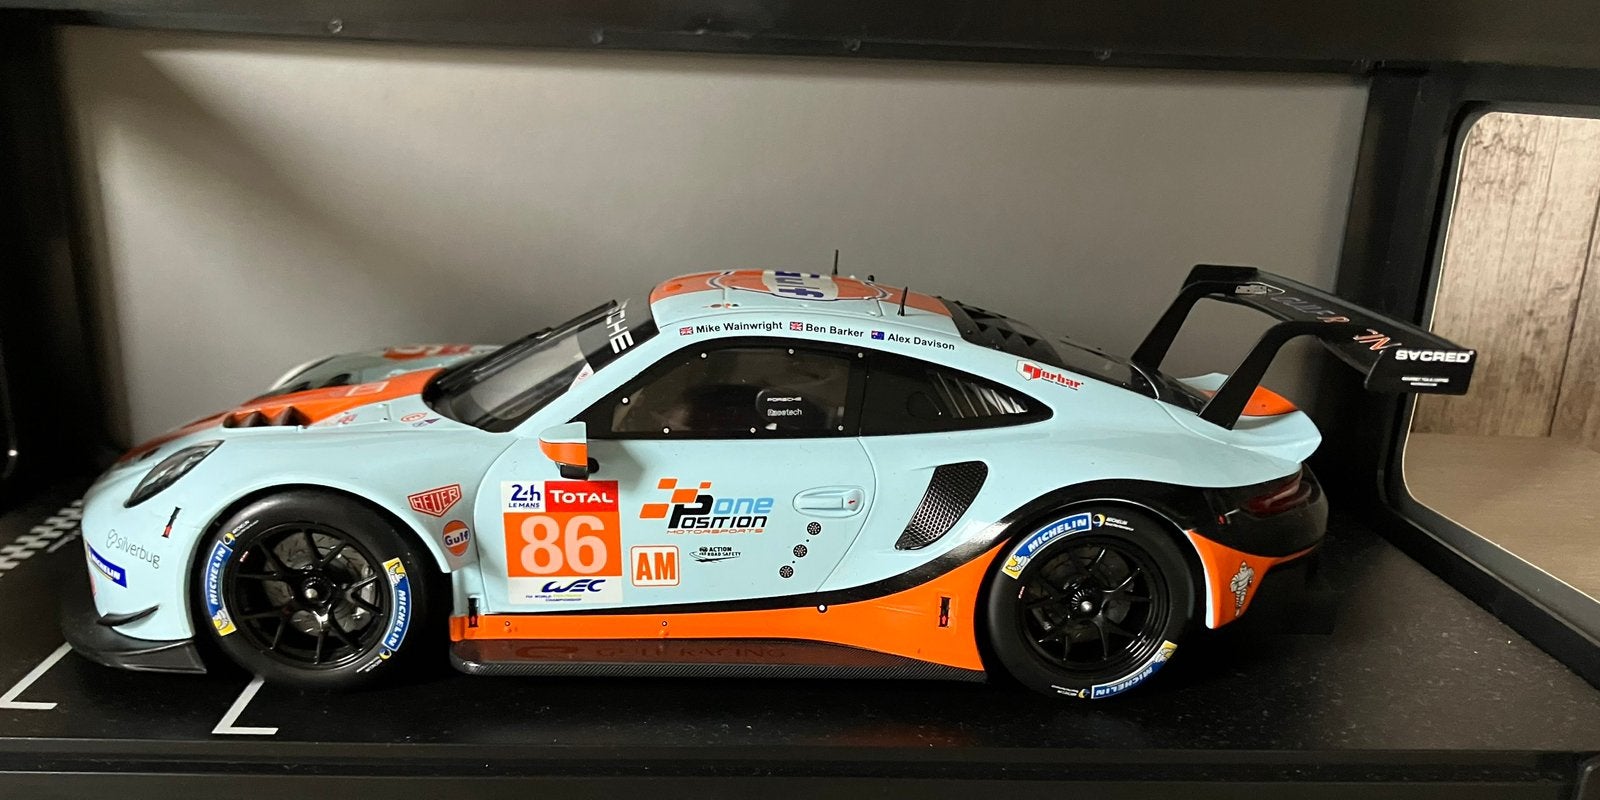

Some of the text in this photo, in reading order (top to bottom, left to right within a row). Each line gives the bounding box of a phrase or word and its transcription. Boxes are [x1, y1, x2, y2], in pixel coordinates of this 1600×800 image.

[696, 321, 783, 333] Mike Wainwright
[806, 323, 864, 338] Ben Barker
[888, 333, 955, 350] Alex Davison
[1395, 350, 1470, 363] SACRED
[413, 488, 457, 513] HEUER
[511, 484, 541, 501] 24h
[549, 489, 614, 504] TOTAL
[713, 498, 774, 515] one
[444, 530, 469, 546] Gulf
[1027, 518, 1087, 552] MICHELIN
[115, 537, 161, 569] silverbug
[520, 515, 608, 575] 86
[636, 552, 675, 580] AM
[210, 547, 226, 605] MICHELIN
[541, 579, 606, 593] WEC
[389, 590, 407, 647] MICHELIN
[1096, 667, 1153, 695] MICHELIN
